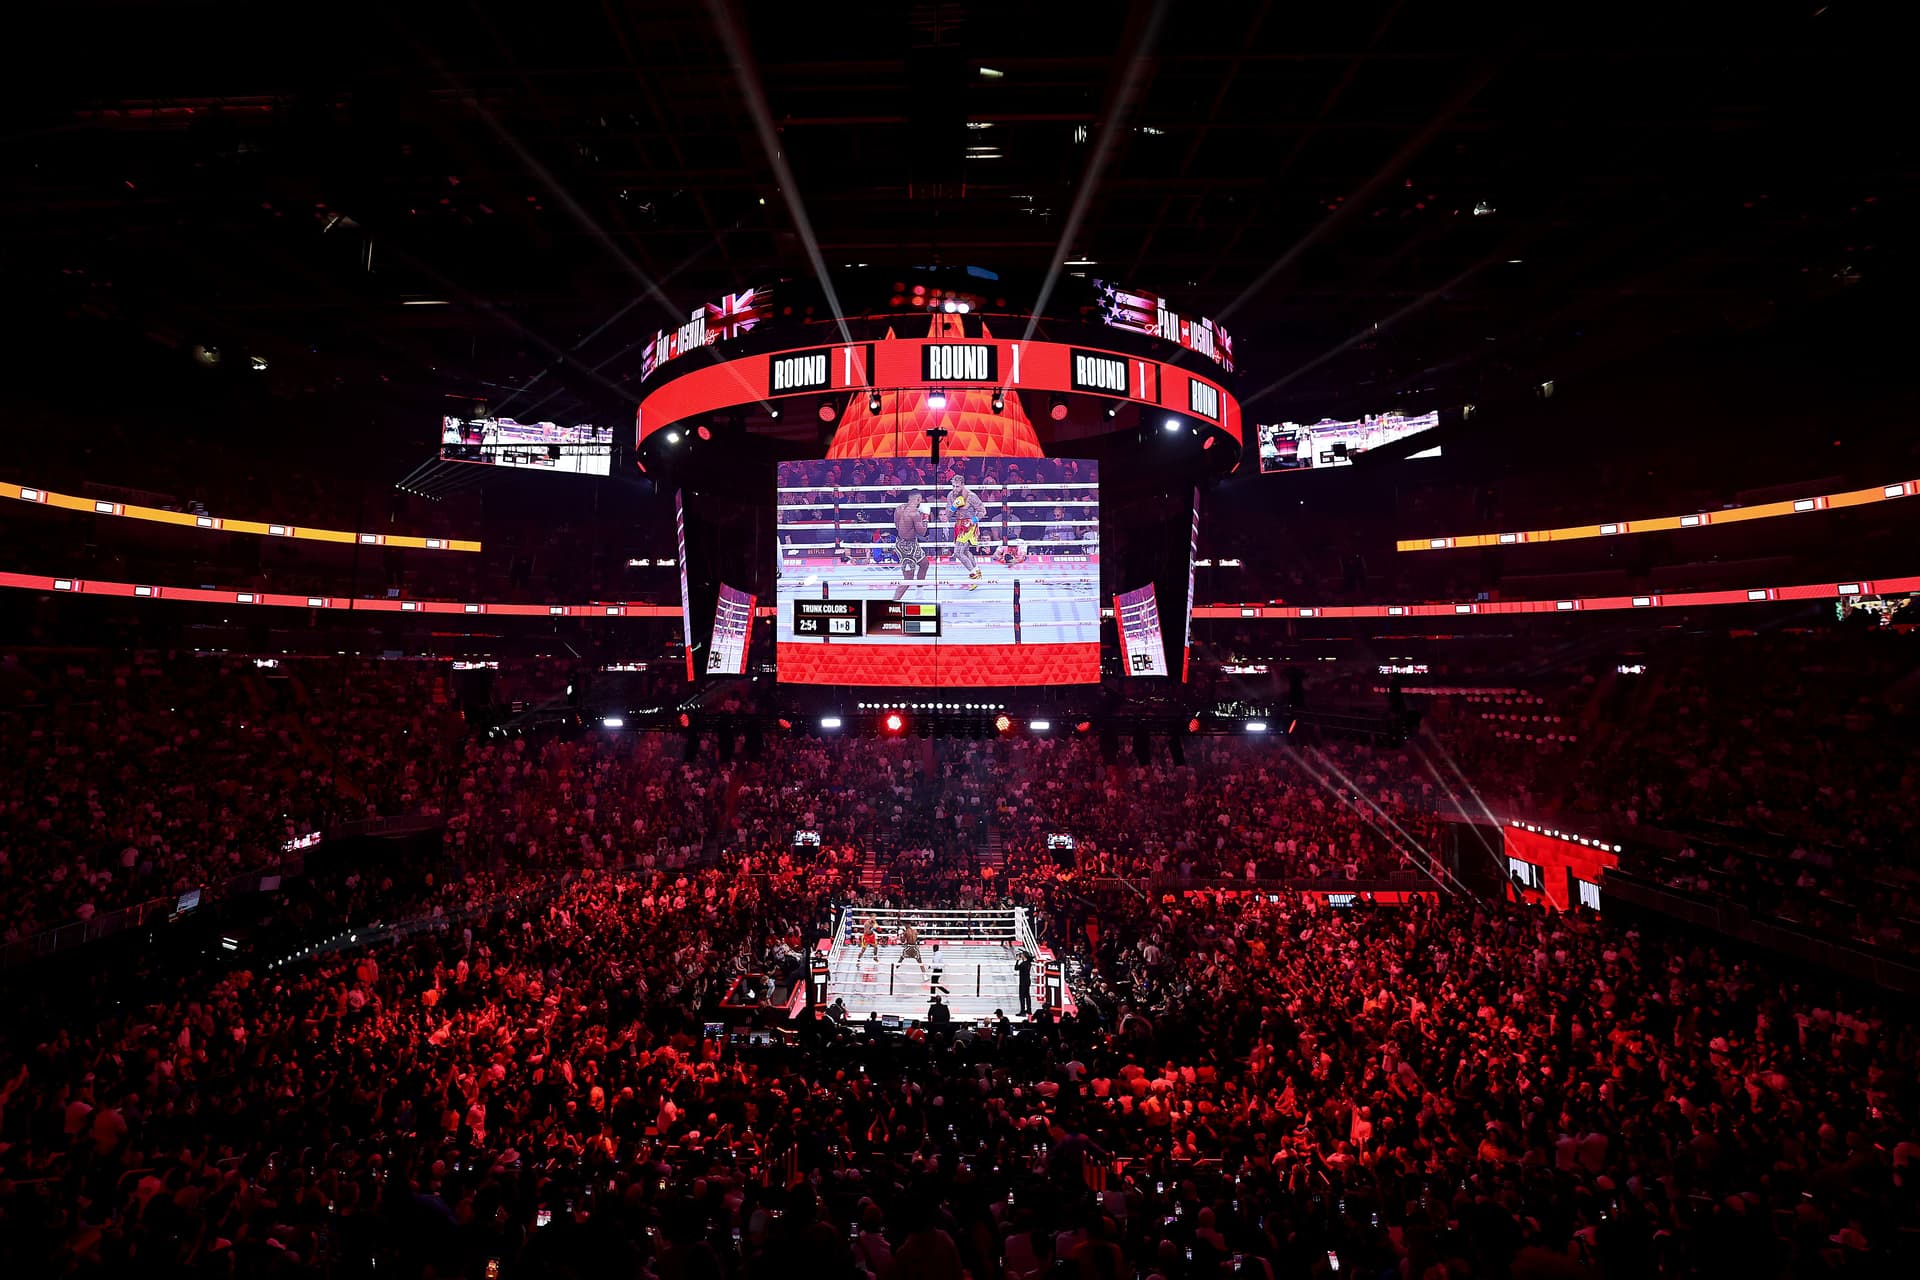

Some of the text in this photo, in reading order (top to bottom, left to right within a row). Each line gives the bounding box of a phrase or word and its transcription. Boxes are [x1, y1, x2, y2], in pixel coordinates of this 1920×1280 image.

[677, 318, 705, 355] JOSHUA
[1158, 309, 1180, 343] PAUL
[774, 348, 851, 390] ROUND 1
[929, 344, 1020, 384] ROUND 1
[1076, 355, 1146, 399] ROUND 1
[1191, 379, 1218, 419] ROUND
[800, 619, 817, 631] 2:54
[802, 604, 848, 614] TRUNK COLORS
